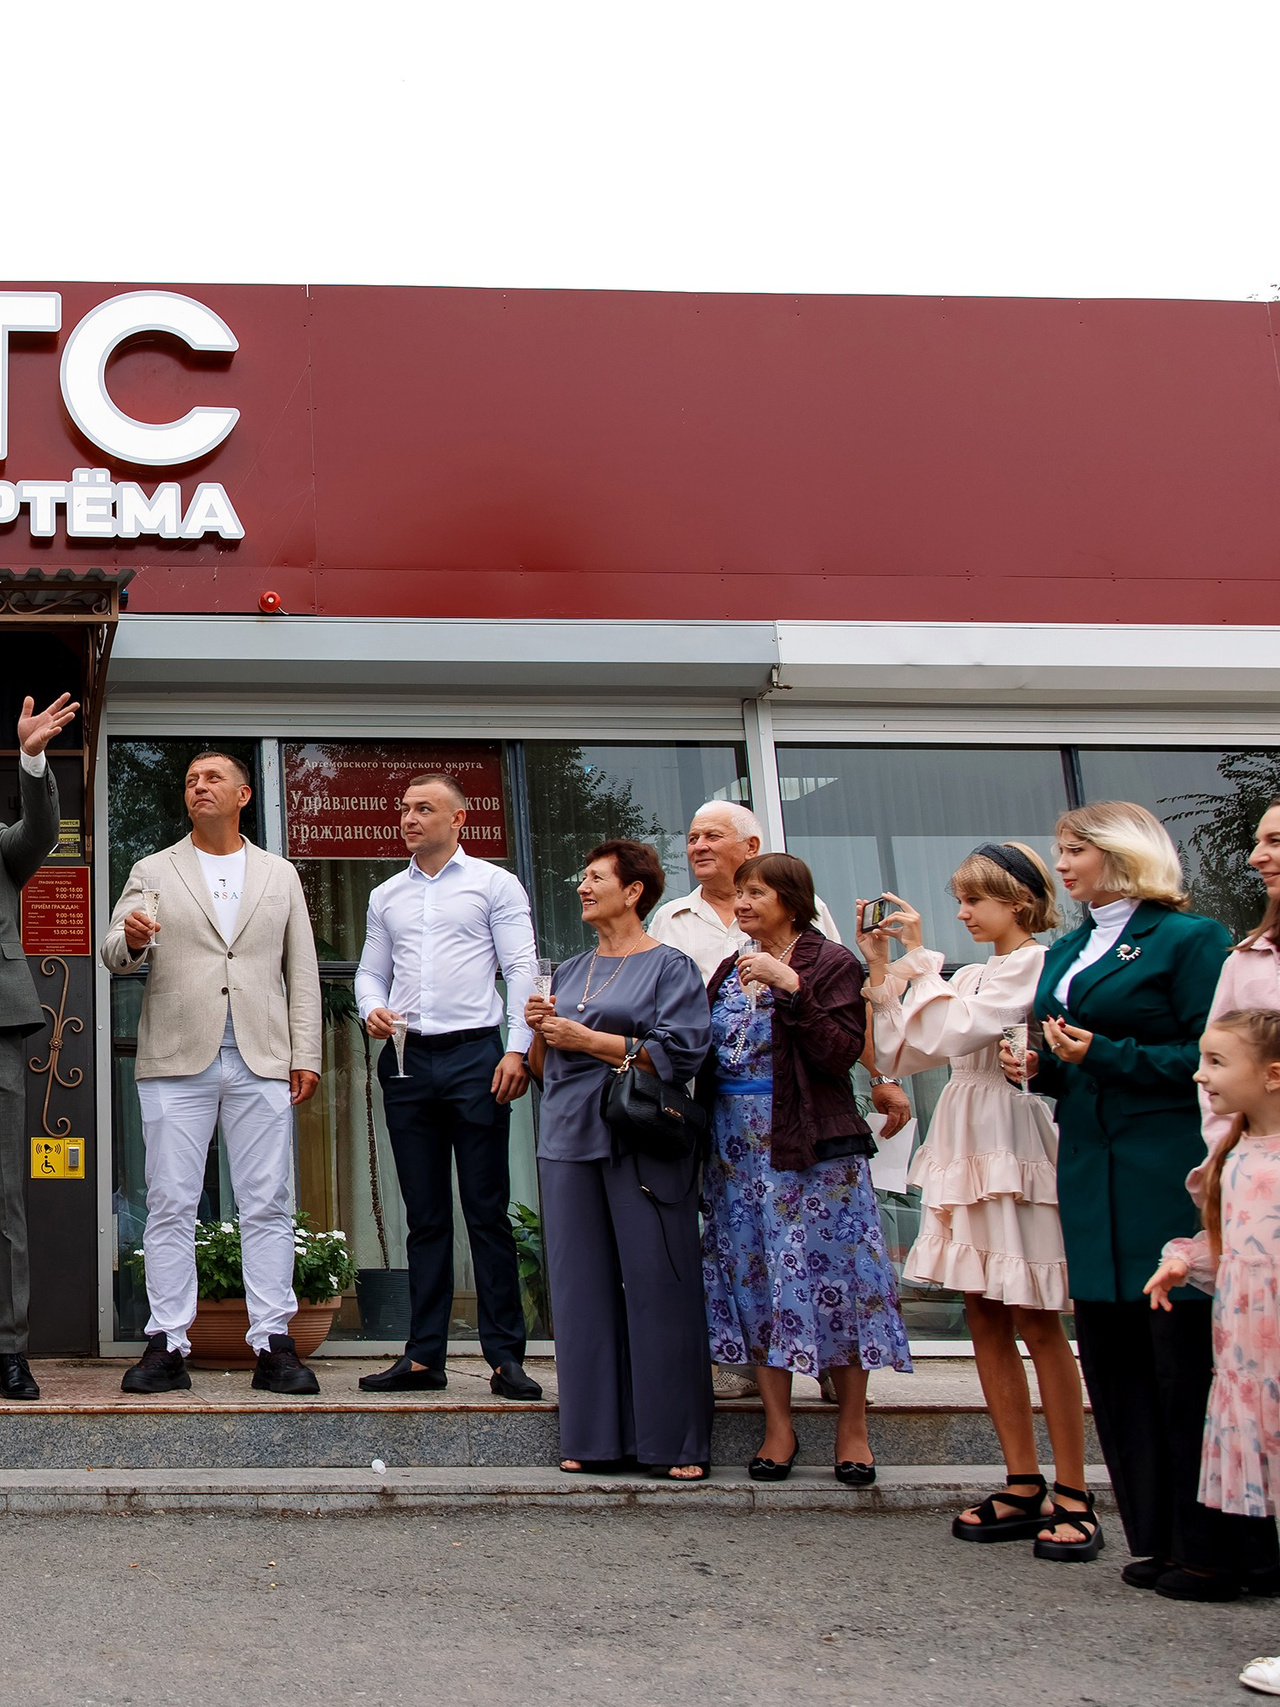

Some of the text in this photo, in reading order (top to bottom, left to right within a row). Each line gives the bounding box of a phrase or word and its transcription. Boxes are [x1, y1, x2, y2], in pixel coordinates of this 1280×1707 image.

[382, 761, 442, 771] городского
[290, 790, 388, 816] Управление
[463, 796, 501, 811] ктов
